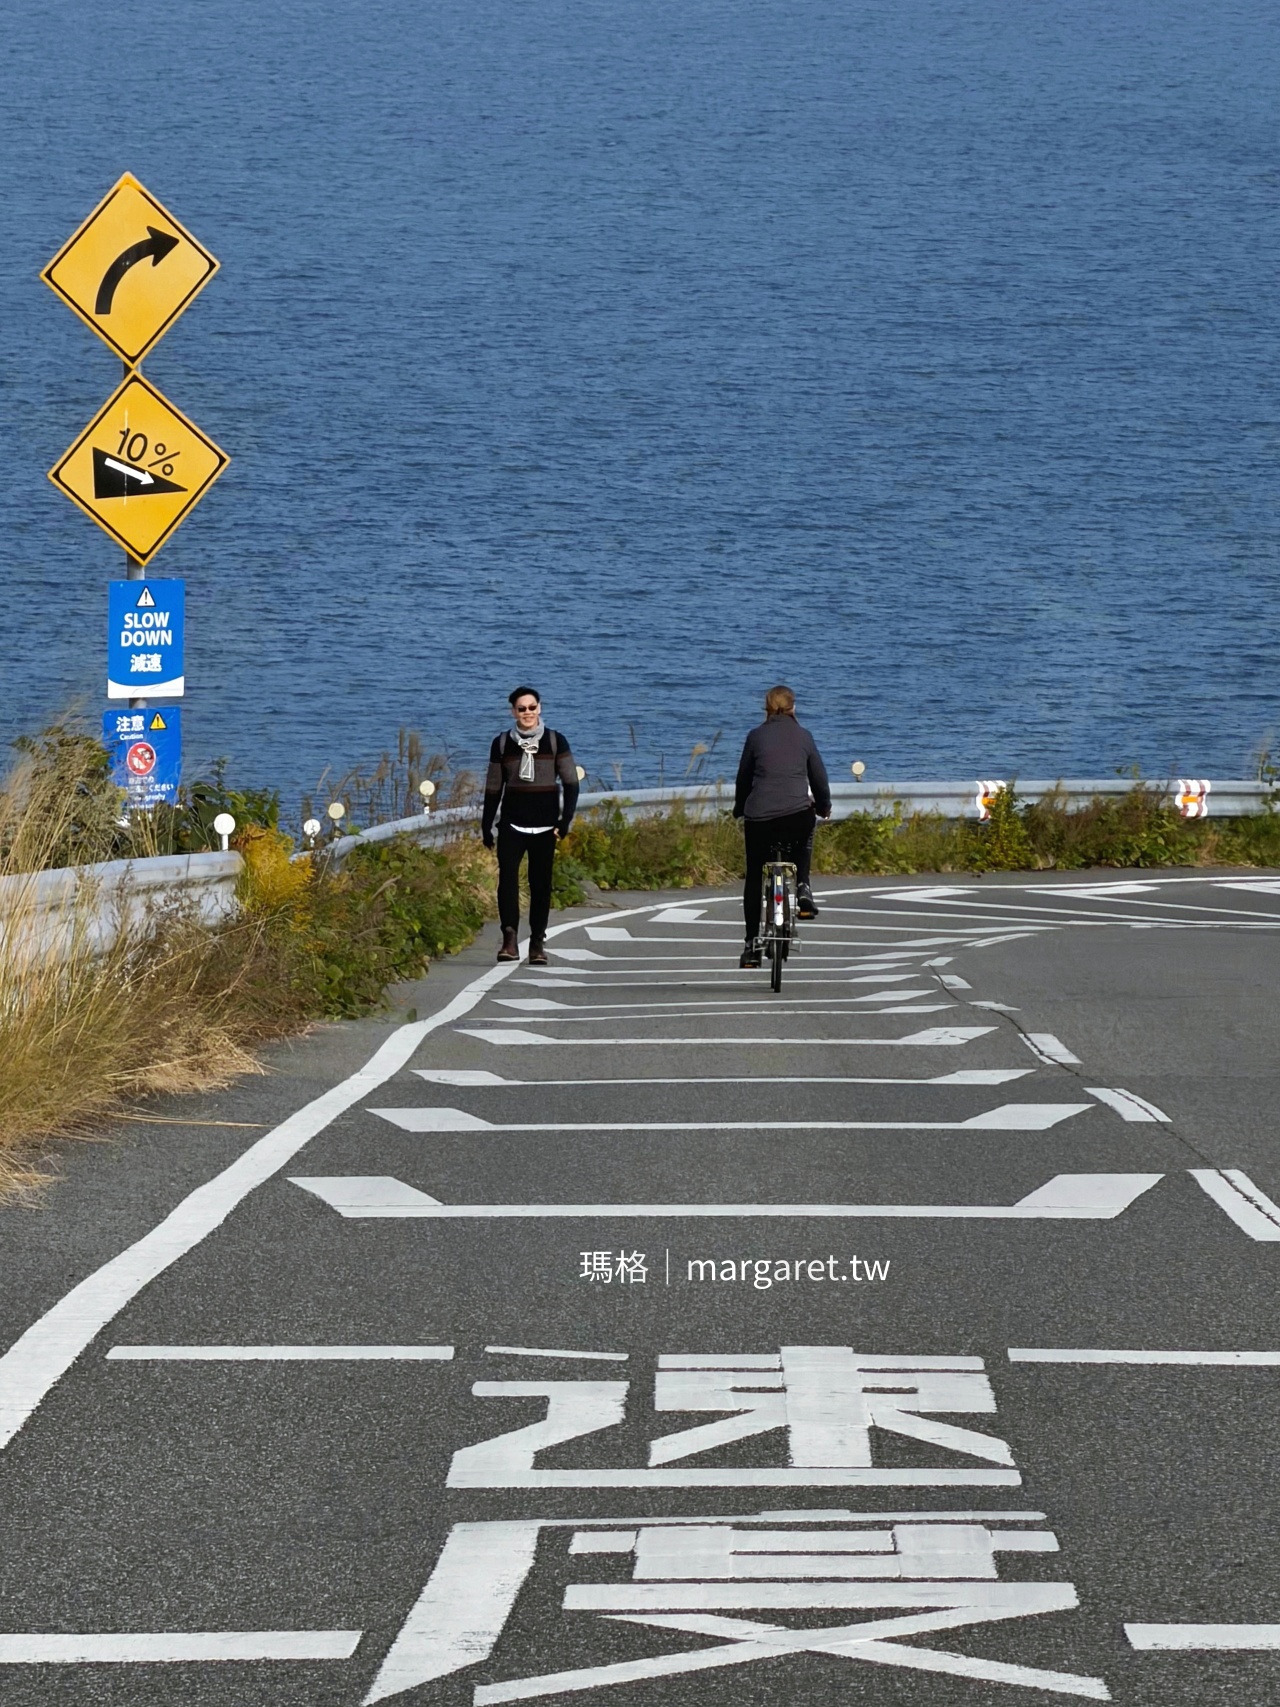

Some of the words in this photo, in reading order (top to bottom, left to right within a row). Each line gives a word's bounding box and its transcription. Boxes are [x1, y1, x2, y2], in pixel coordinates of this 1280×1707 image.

[117, 427, 181, 477] 10%
[123, 611, 170, 629] SLOW
[120, 629, 172, 647] DOWN
[130, 653, 162, 672] 減速
[116, 715, 145, 732] 注意
[119, 733, 144, 741] Caution
